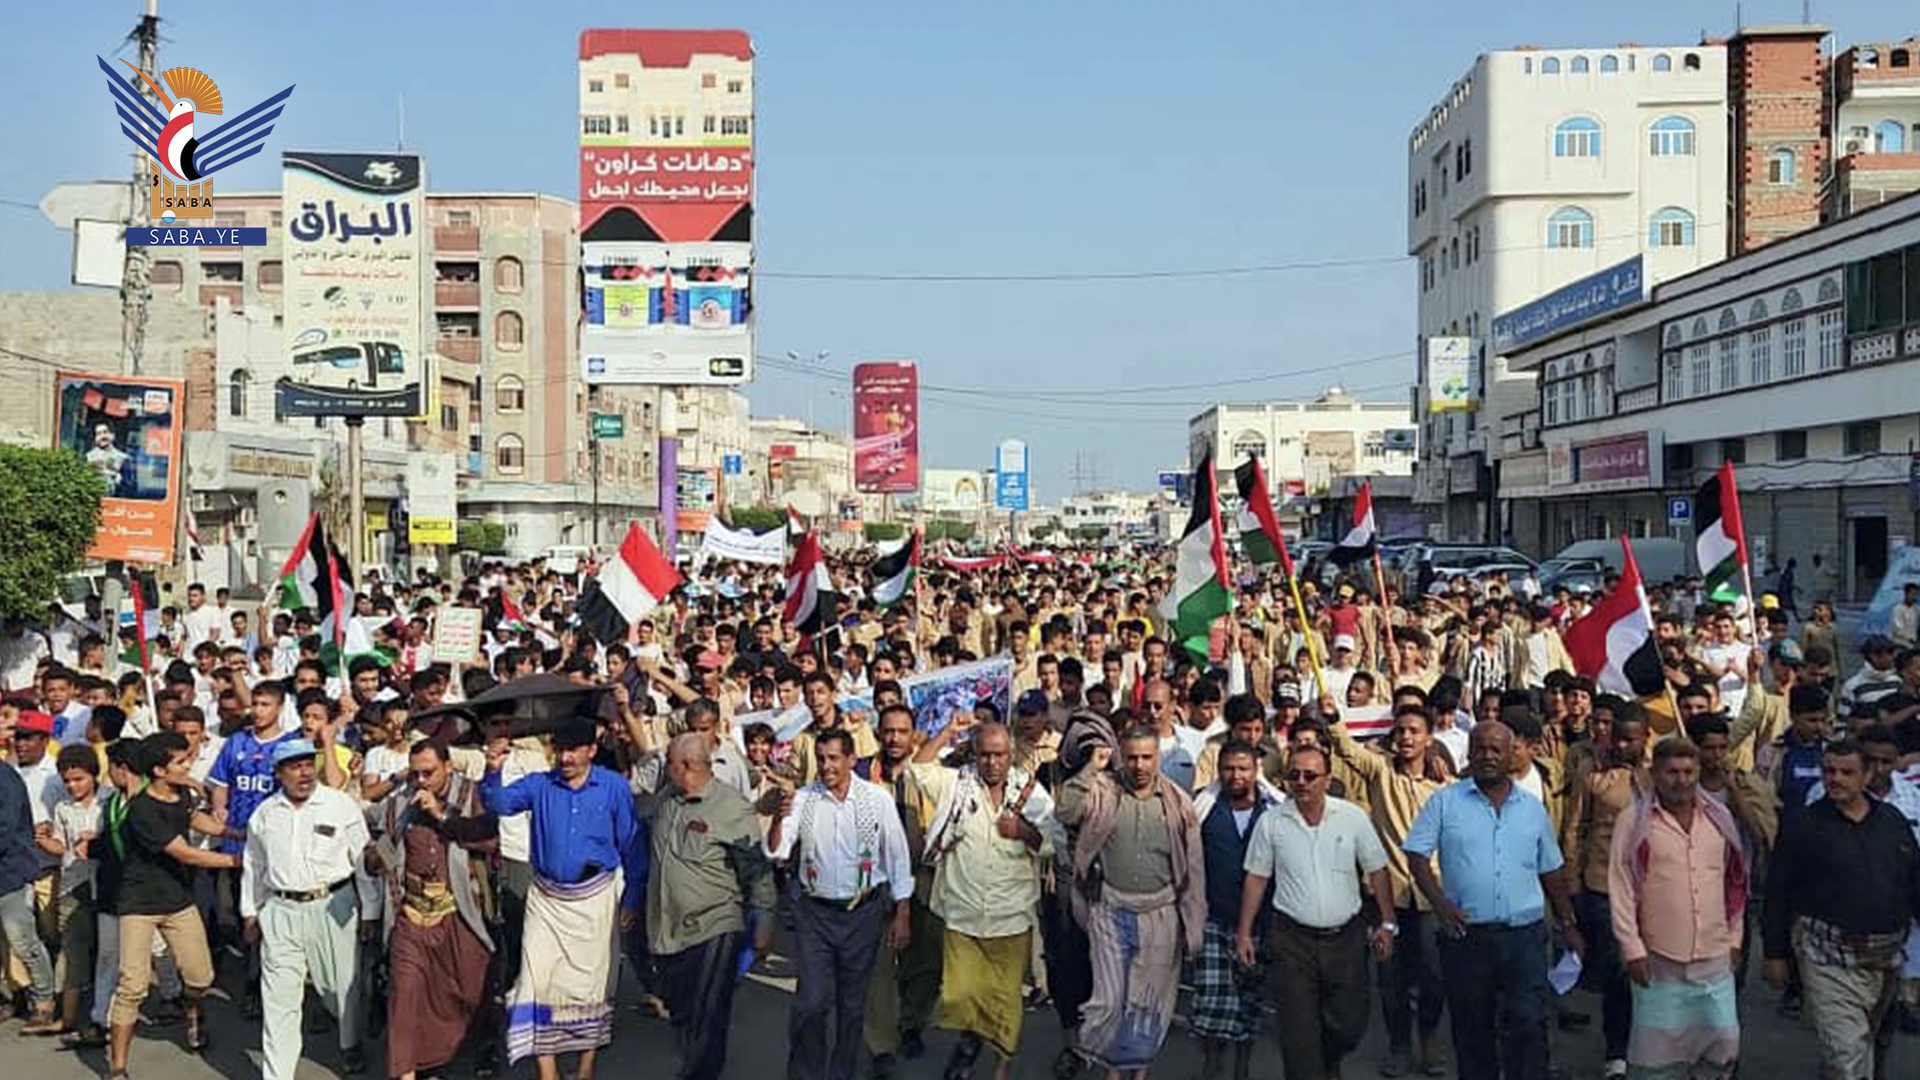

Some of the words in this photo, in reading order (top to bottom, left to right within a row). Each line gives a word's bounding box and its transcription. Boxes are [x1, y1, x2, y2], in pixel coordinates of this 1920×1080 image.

[634, 180, 700, 200] محيطك
[290, 200, 411, 245] البراق
[1673, 501, 1686, 517] P
